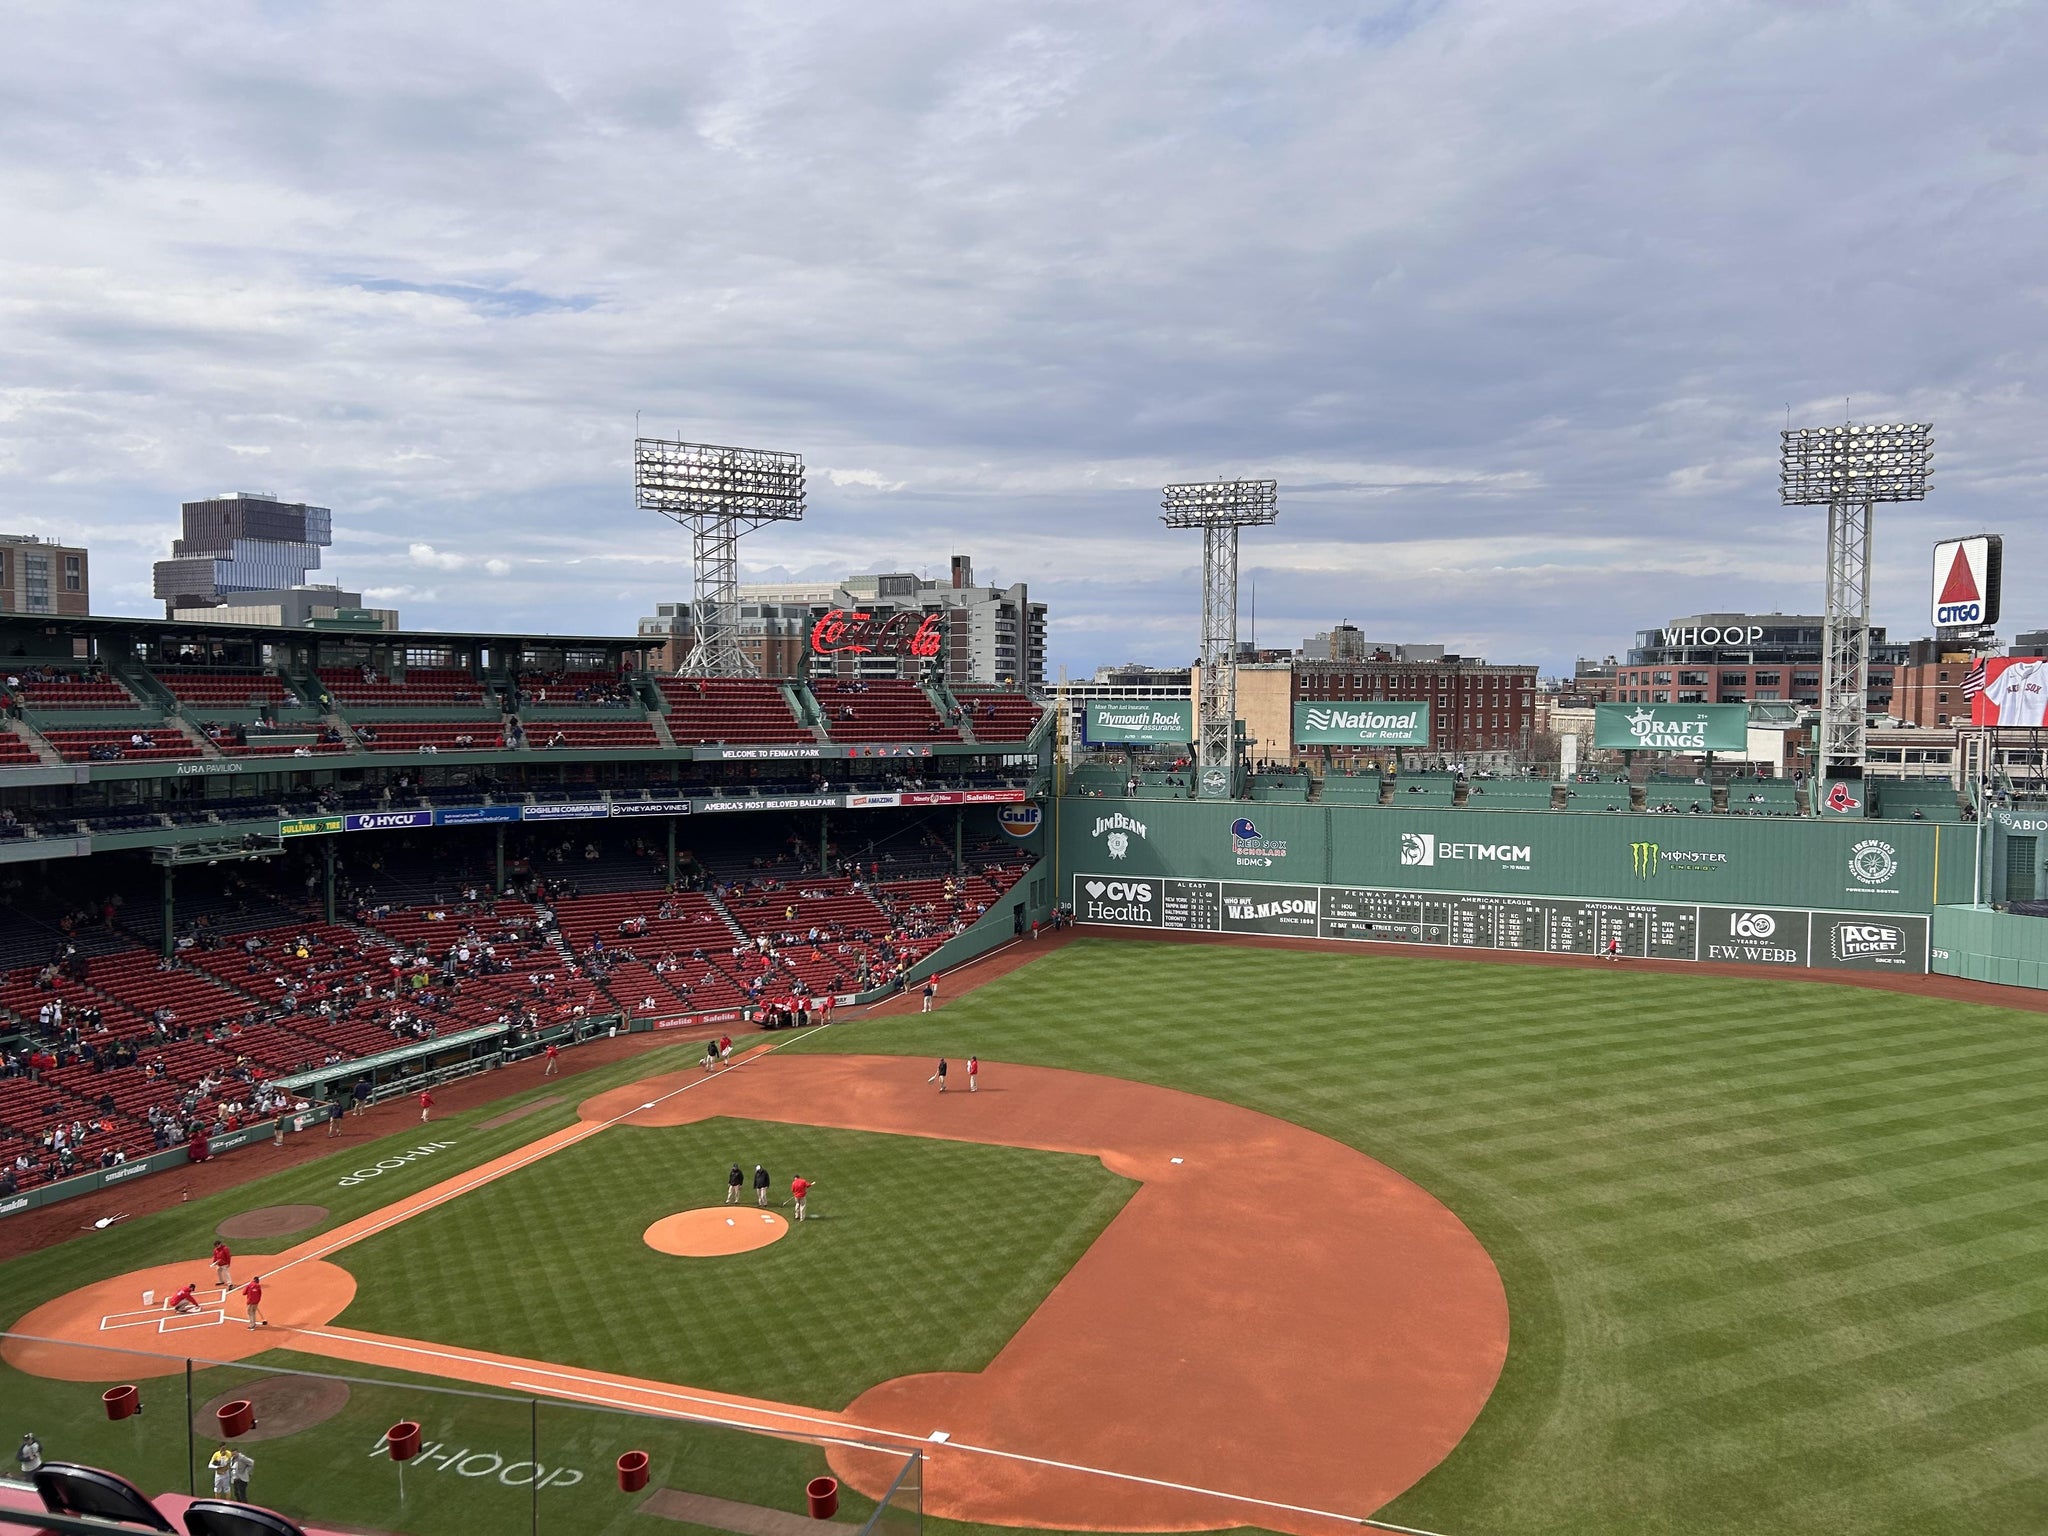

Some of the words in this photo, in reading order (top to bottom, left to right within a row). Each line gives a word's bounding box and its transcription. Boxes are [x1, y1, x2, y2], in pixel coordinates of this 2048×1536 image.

[1937, 604, 1980, 623] CITGO
[1661, 626, 1763, 646] WHOOP
[2025, 683, 2042, 694] SOX
[1098, 711, 1150, 726] Plymouth
[1152, 712, 1181, 725] Rock
[1360, 730, 1376, 739] Car
[1379, 730, 1412, 739] Rental
[1630, 720, 1708, 736] DRAFT
[1640, 735, 1704, 748] KINGS
[801, 749, 820, 757] PARK
[206, 763, 241, 773] PAVILION
[561, 805, 607, 813] COMPANIES
[704, 802, 743, 811] AMERICA'S
[745, 801, 765, 809] MOST
[766, 800, 798, 808] BELOVED
[800, 799, 836, 808] BALLPARK
[377, 814, 413, 827] HYCU
[999, 808, 1037, 822] Gulf
[282, 822, 316, 834] SULLIVAN
[326, 820, 340, 830] TIRE
[1236, 840, 1261, 849] RED
[1263, 840, 1287, 849] SOX
[1851, 840, 1878, 853] IBEW
[1879, 842, 1895, 855] 103
[1236, 848, 1287, 857] SCHOLARS
[1439, 843, 1530, 862] BETMGM
[1661, 850, 1727, 863] MONSTER
[1237, 858, 1263, 866] BIDMC
[1856, 861, 1898, 885] CONTRACTORS
[1107, 882, 1152, 901] CVS
[1088, 901, 1152, 921] Health
[1730, 912, 1776, 938] 160
[1846, 926, 1897, 942] ACE
[1708, 945, 1739, 959] F.W.
[1743, 947, 1797, 962] WEBB
[1846, 942, 1897, 953] TICKET
[1932, 950, 1949, 959] 379
[659, 1018, 692, 1027] Safelite
[703, 1013, 735, 1023] Safelite
[338, 1141, 457, 1186] WHOOP
[105, 1163, 147, 1181] smartwater
